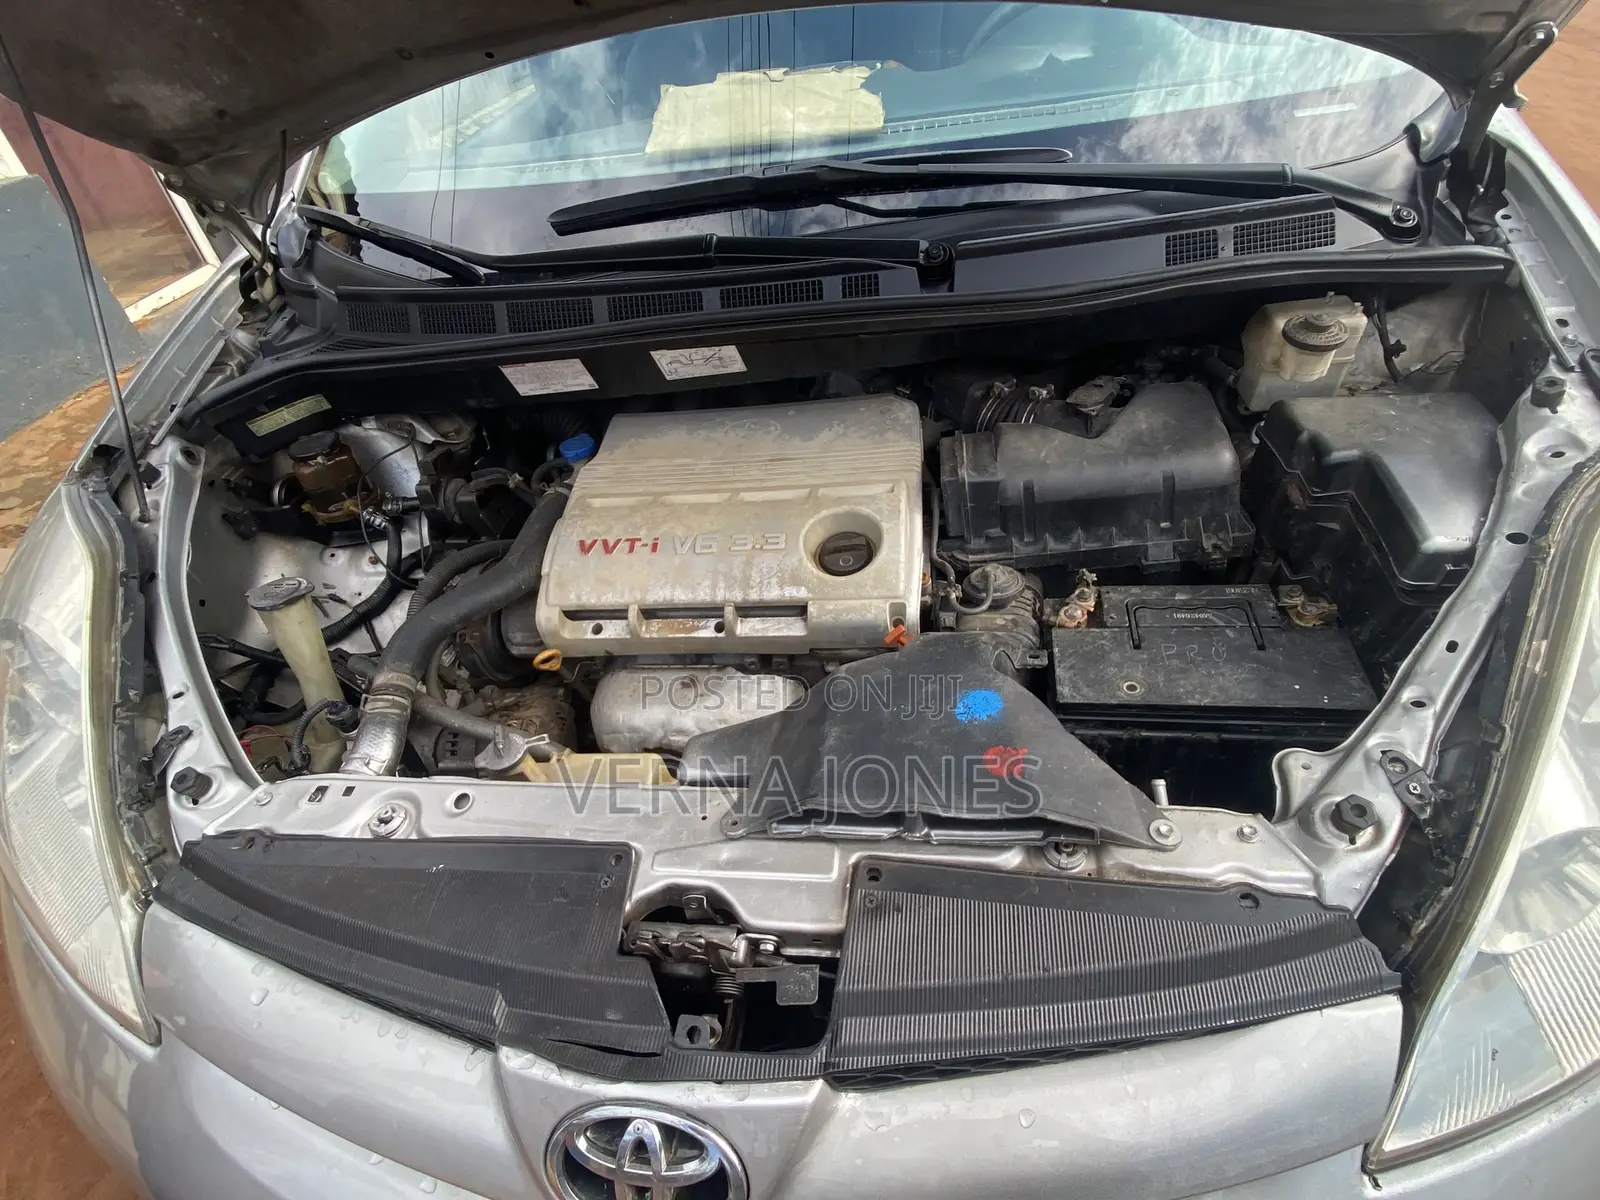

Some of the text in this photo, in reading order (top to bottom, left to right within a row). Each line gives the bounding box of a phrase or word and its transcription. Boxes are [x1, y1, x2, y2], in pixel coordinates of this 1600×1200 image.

[578, 532, 786, 557] VVT-i V6 3.3
